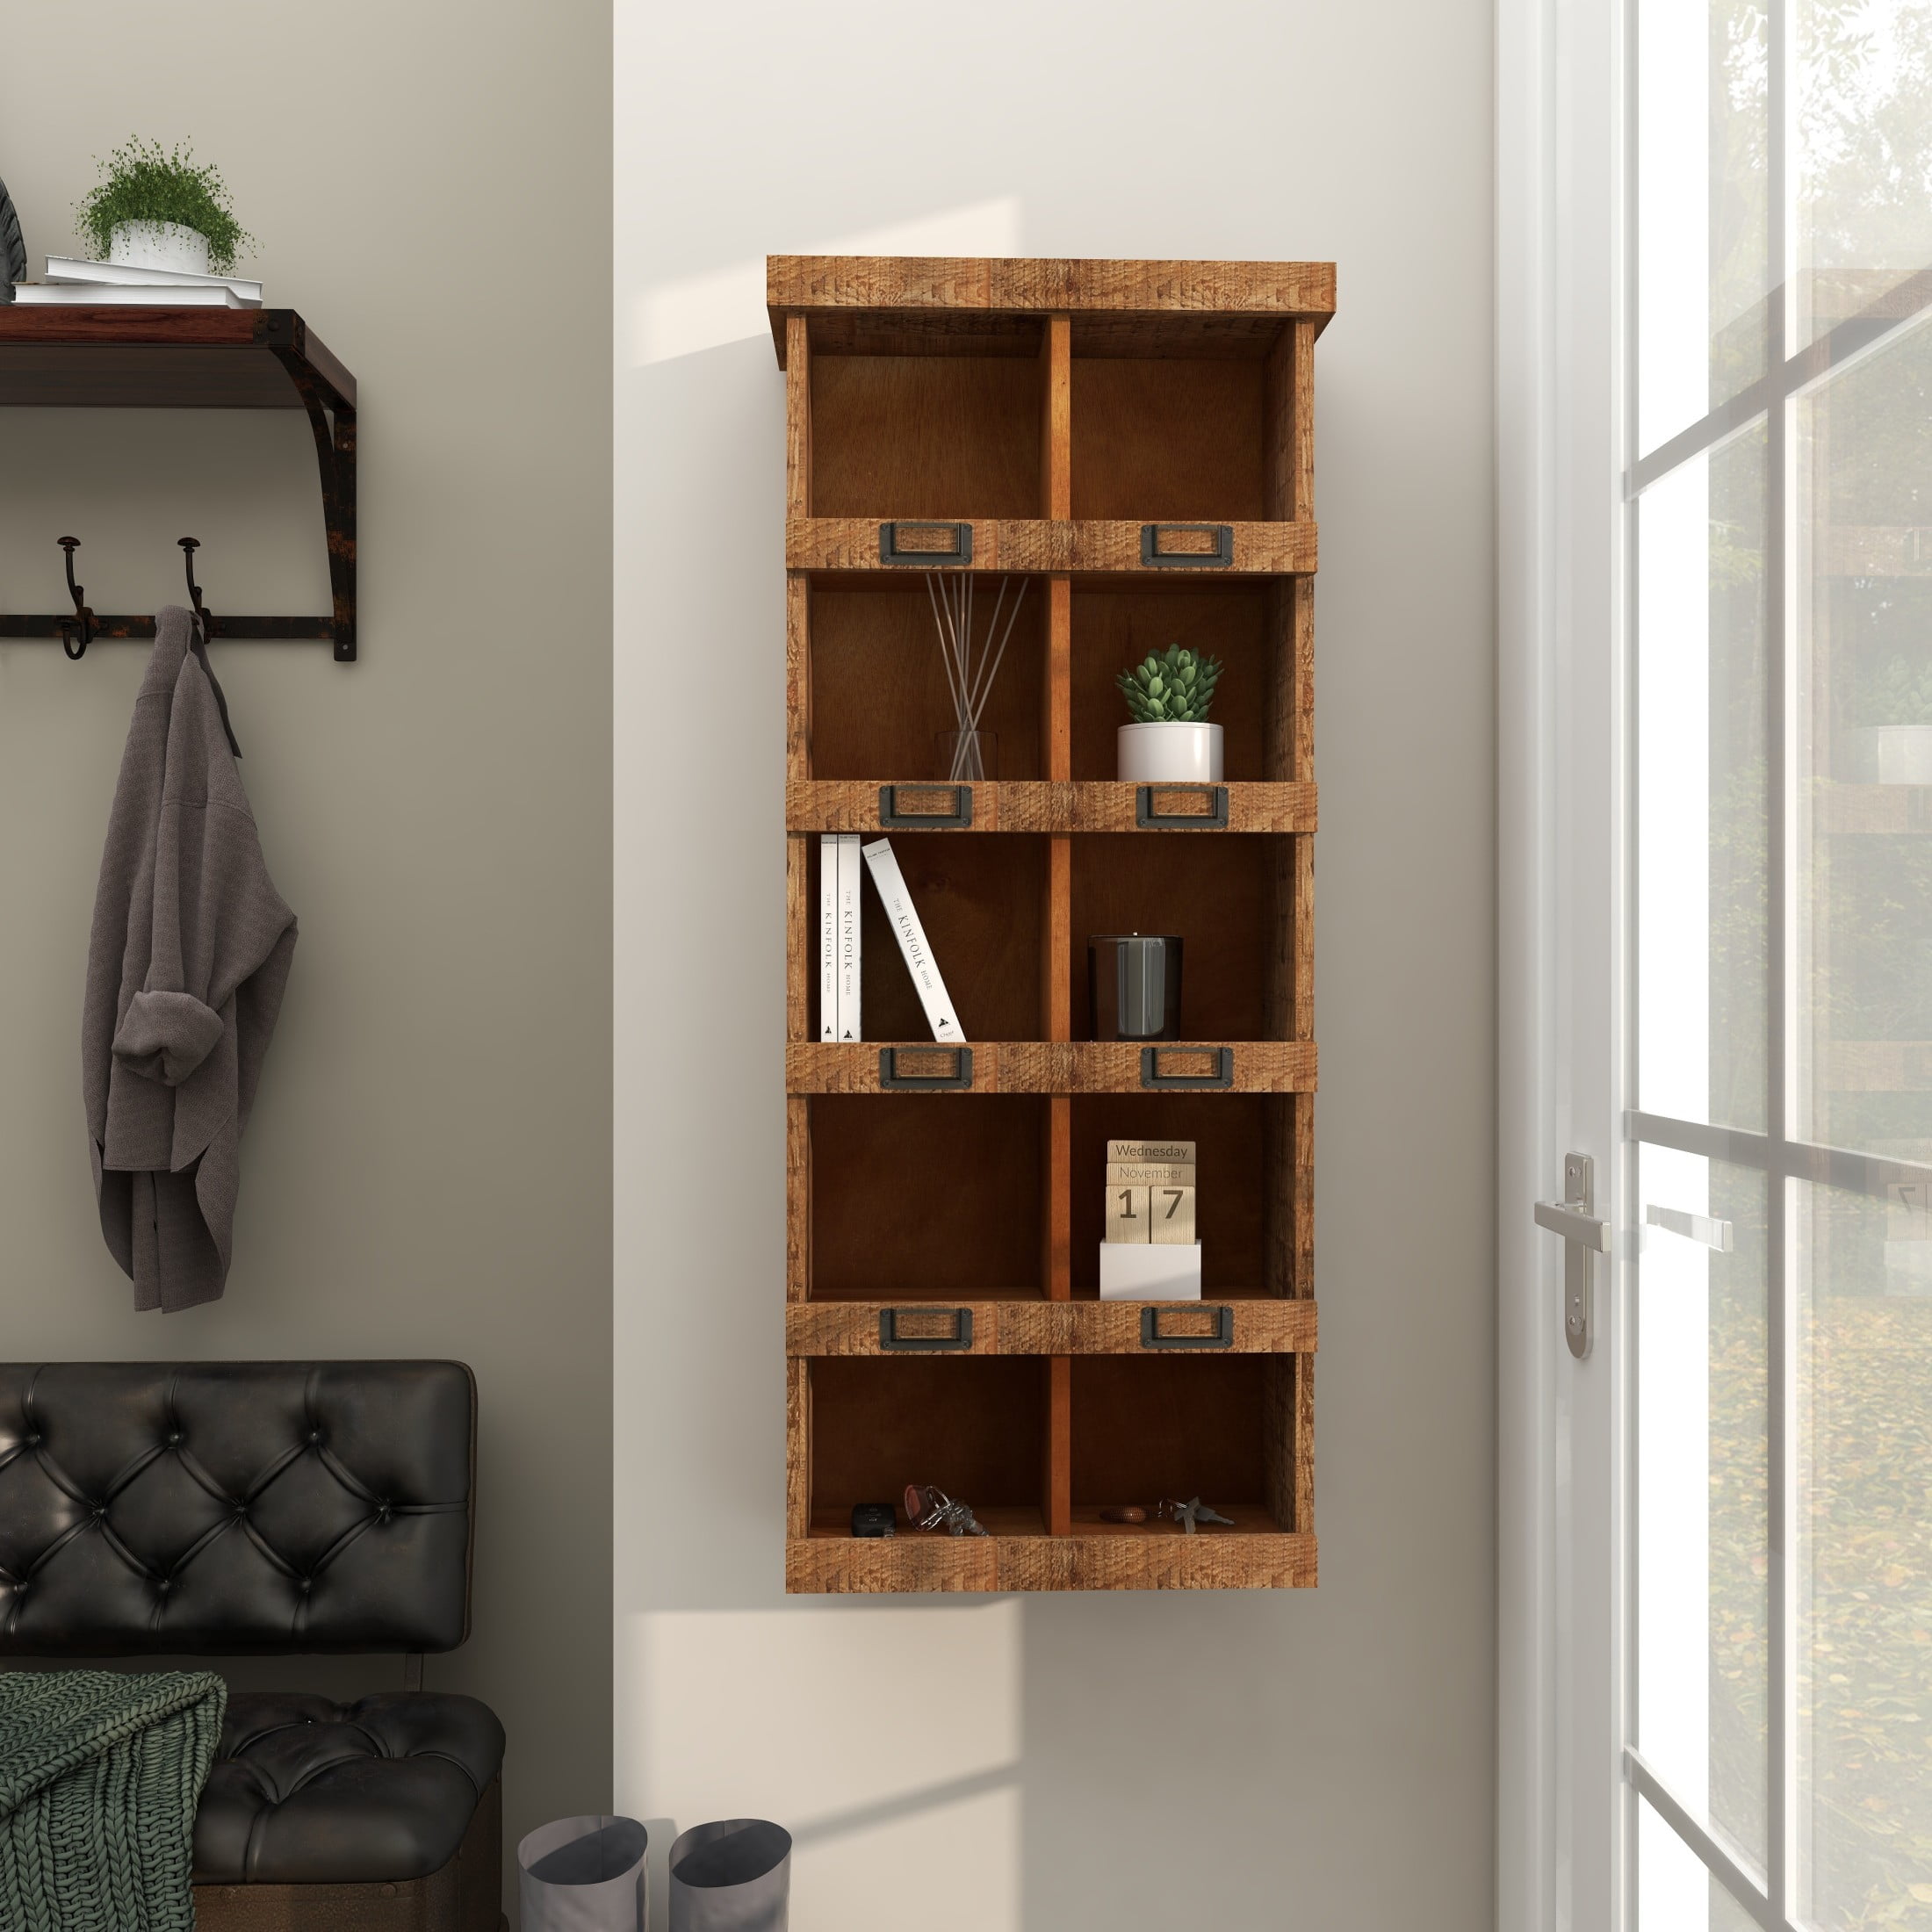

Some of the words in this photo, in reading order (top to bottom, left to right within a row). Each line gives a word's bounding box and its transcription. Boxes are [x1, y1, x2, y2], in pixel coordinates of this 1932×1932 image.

[844, 911, 853, 970] KINFOLK
[893, 898, 903, 912] THE
[898, 915, 926, 968] KINFOLK
[920, 970, 933, 991] HOME
[1115, 1144, 1188, 1158] Wednesday
[1120, 1166, 1182, 1179] November
